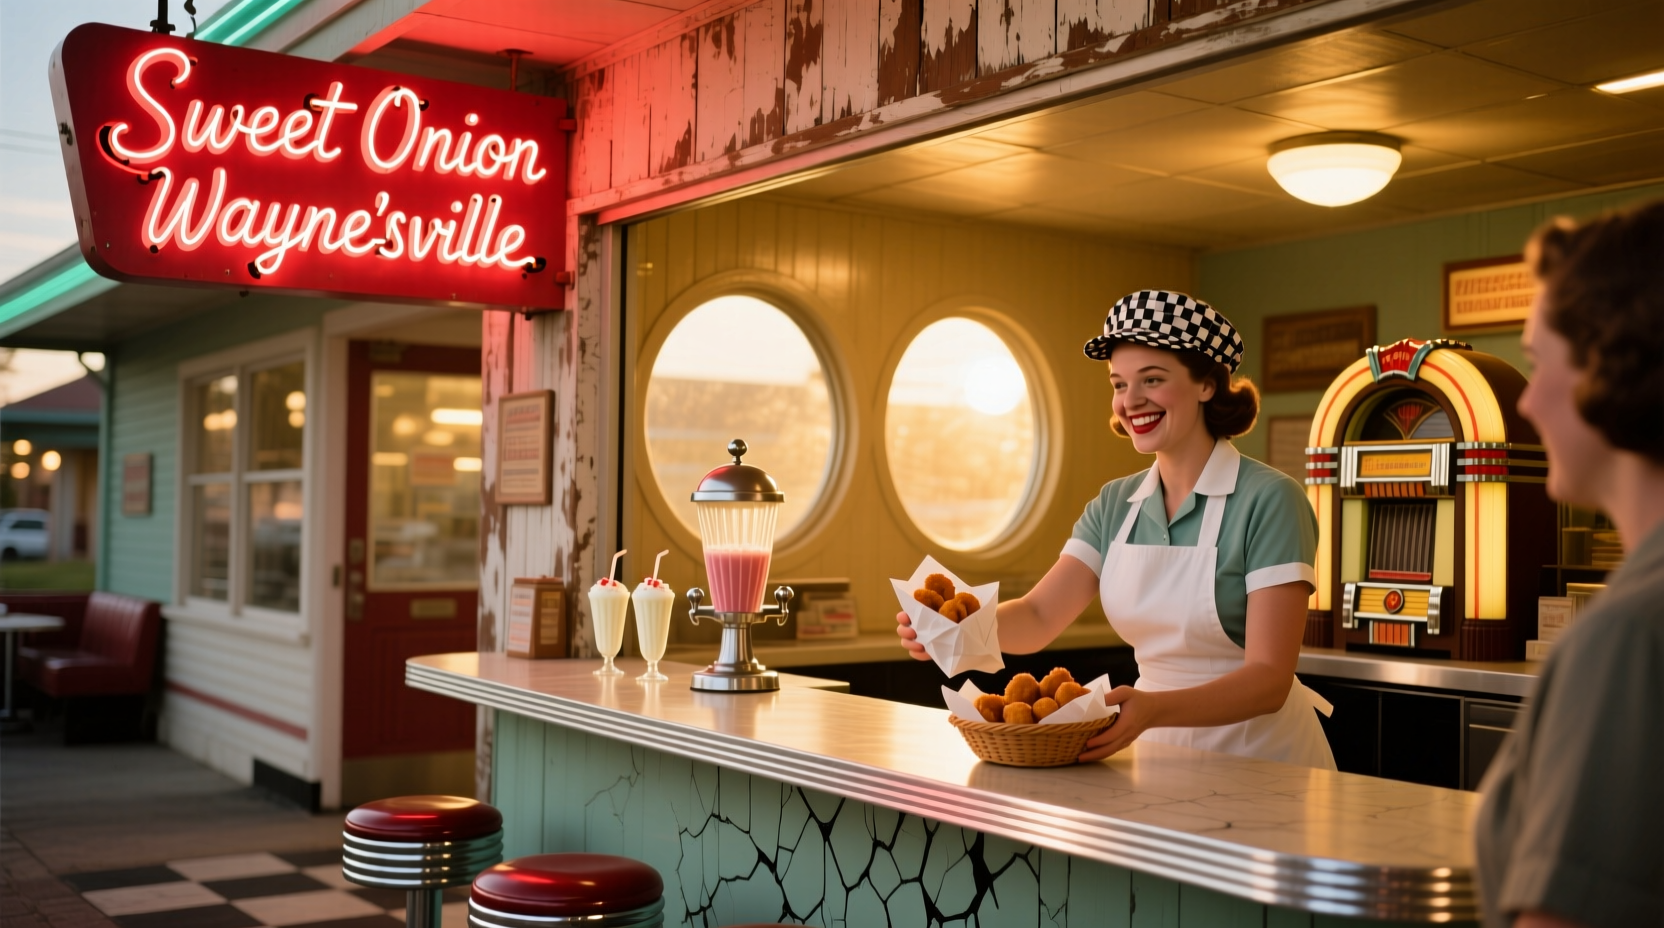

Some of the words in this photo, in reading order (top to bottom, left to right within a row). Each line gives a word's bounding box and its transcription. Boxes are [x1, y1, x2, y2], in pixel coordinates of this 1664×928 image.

[108, 47, 358, 163] Sweet
[361, 85, 547, 182] Onion
[143, 167, 537, 275] Wayne'sville
